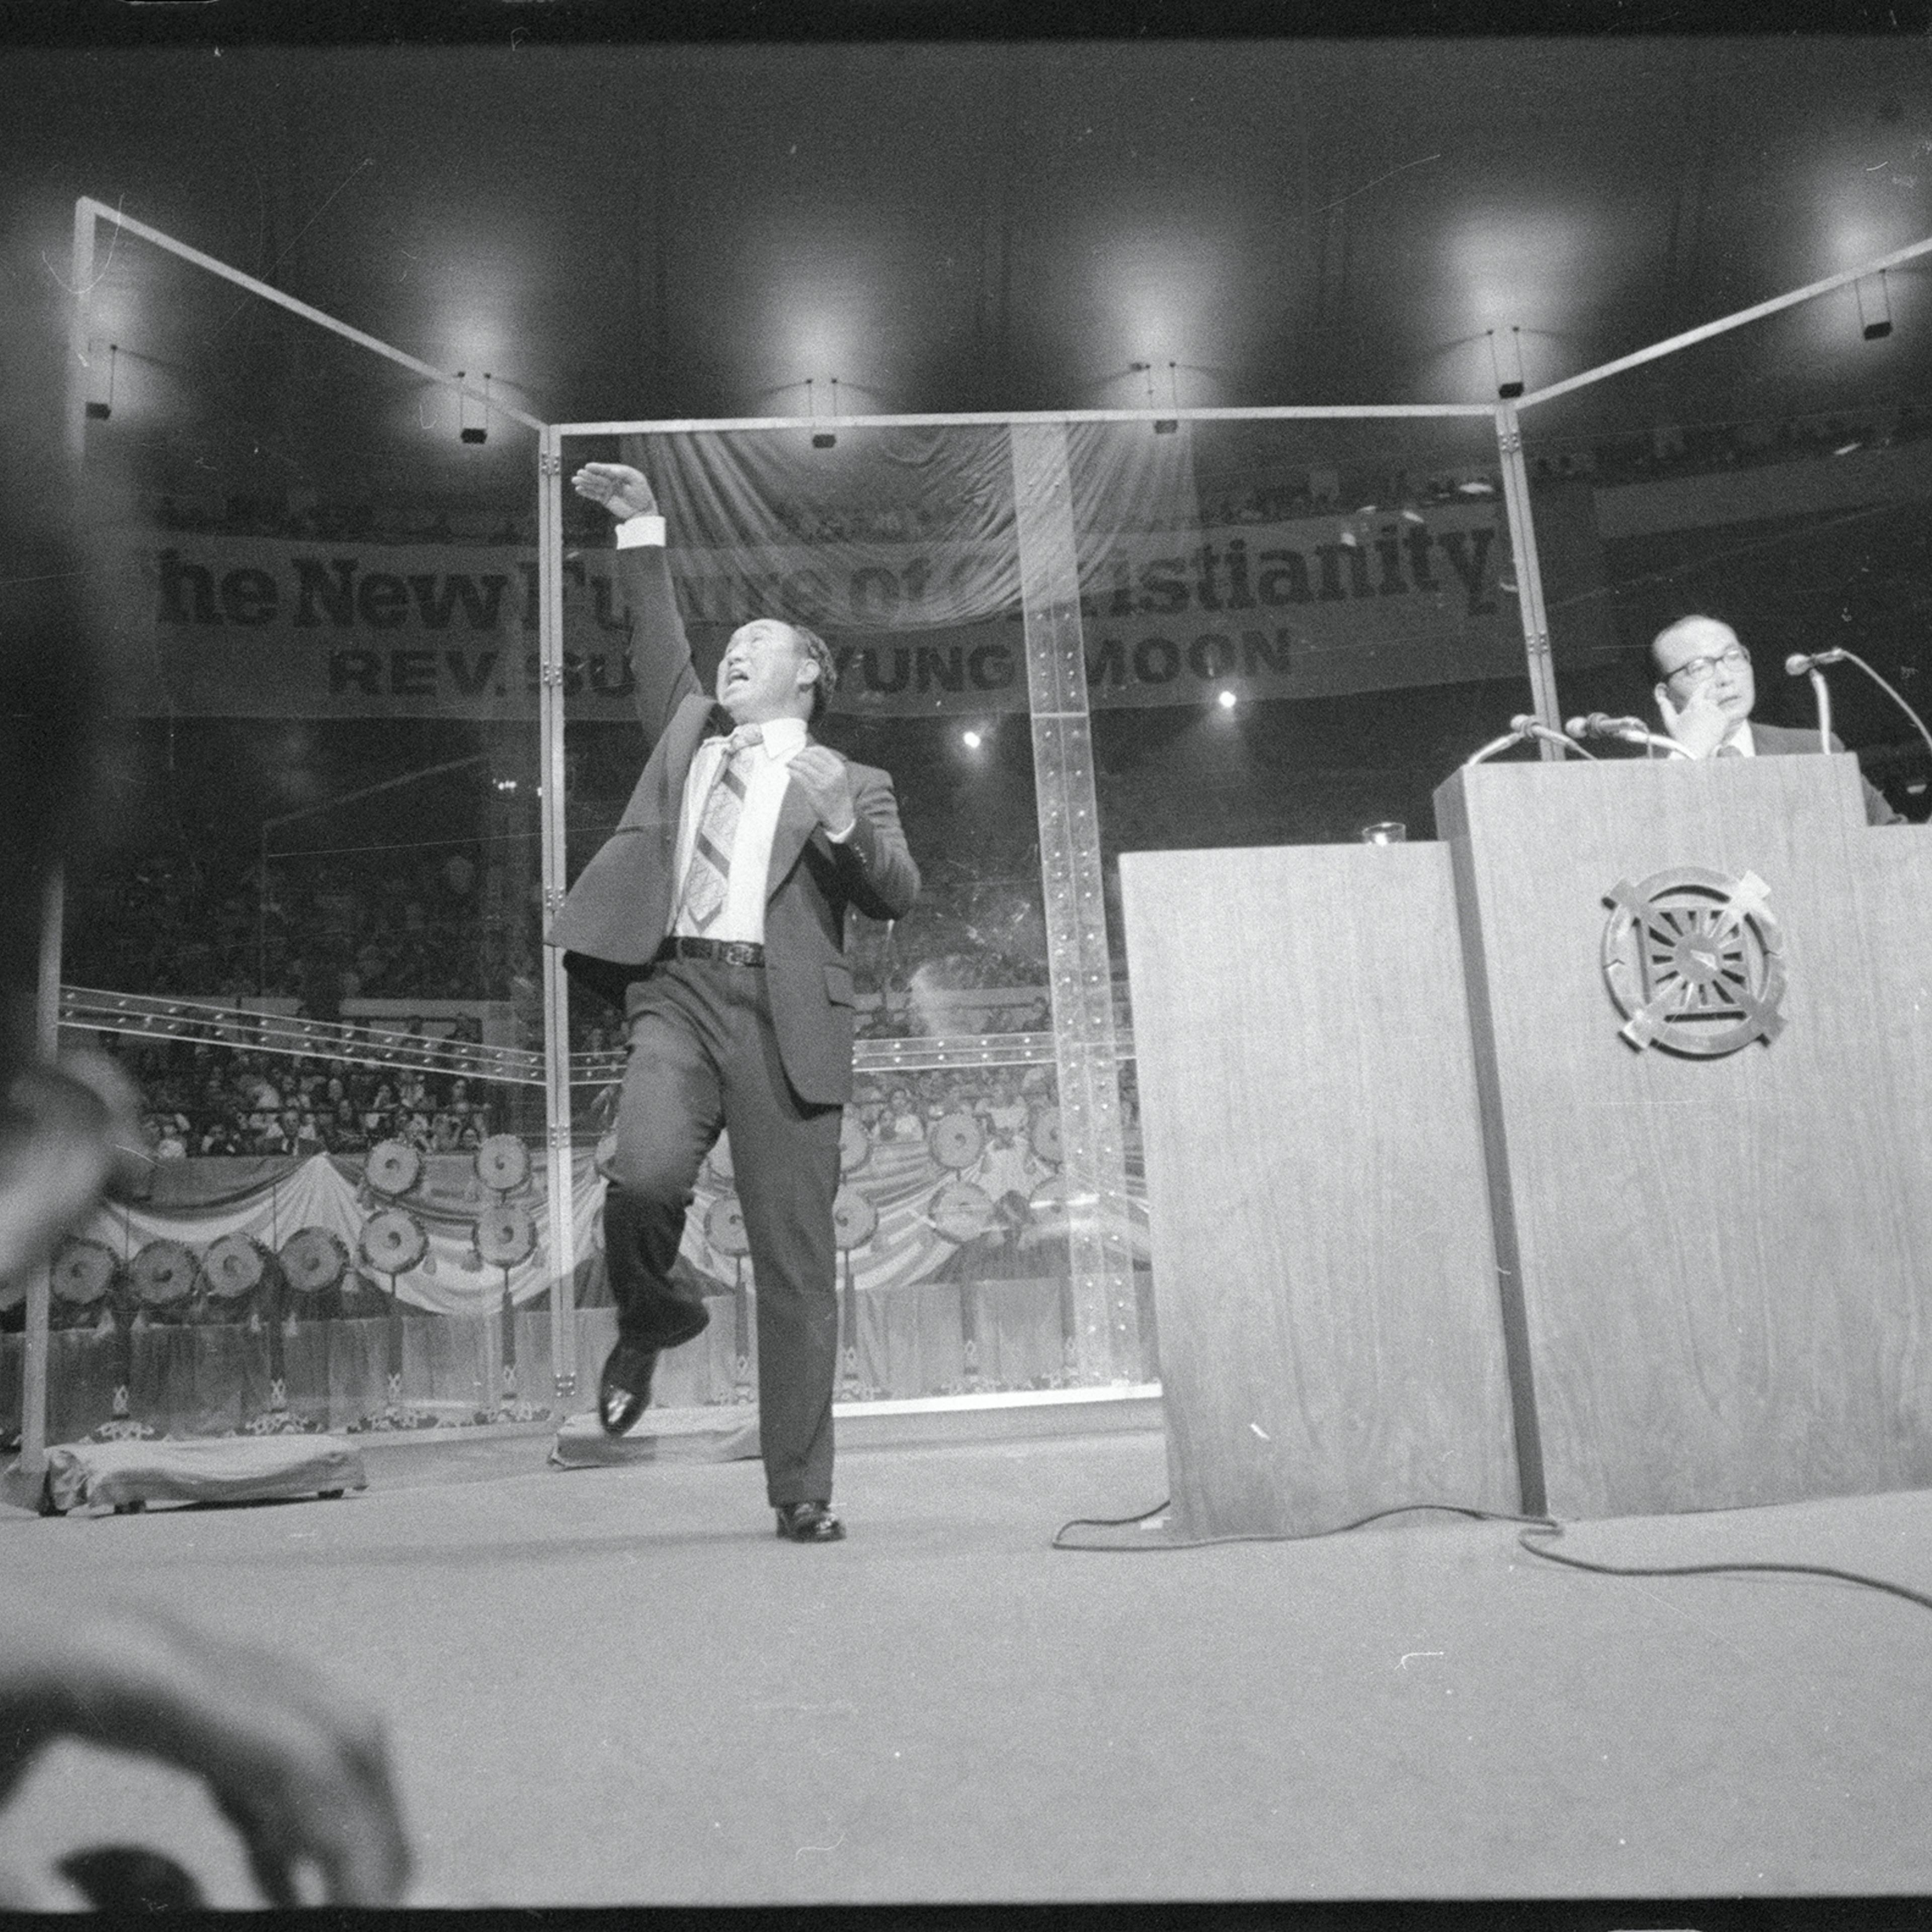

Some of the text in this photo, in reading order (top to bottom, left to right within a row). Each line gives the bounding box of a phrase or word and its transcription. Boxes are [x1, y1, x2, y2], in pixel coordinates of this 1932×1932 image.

[153, 548, 279, 626] he
[290, 557, 506, 629] New
[329, 649, 506, 697] REV.
